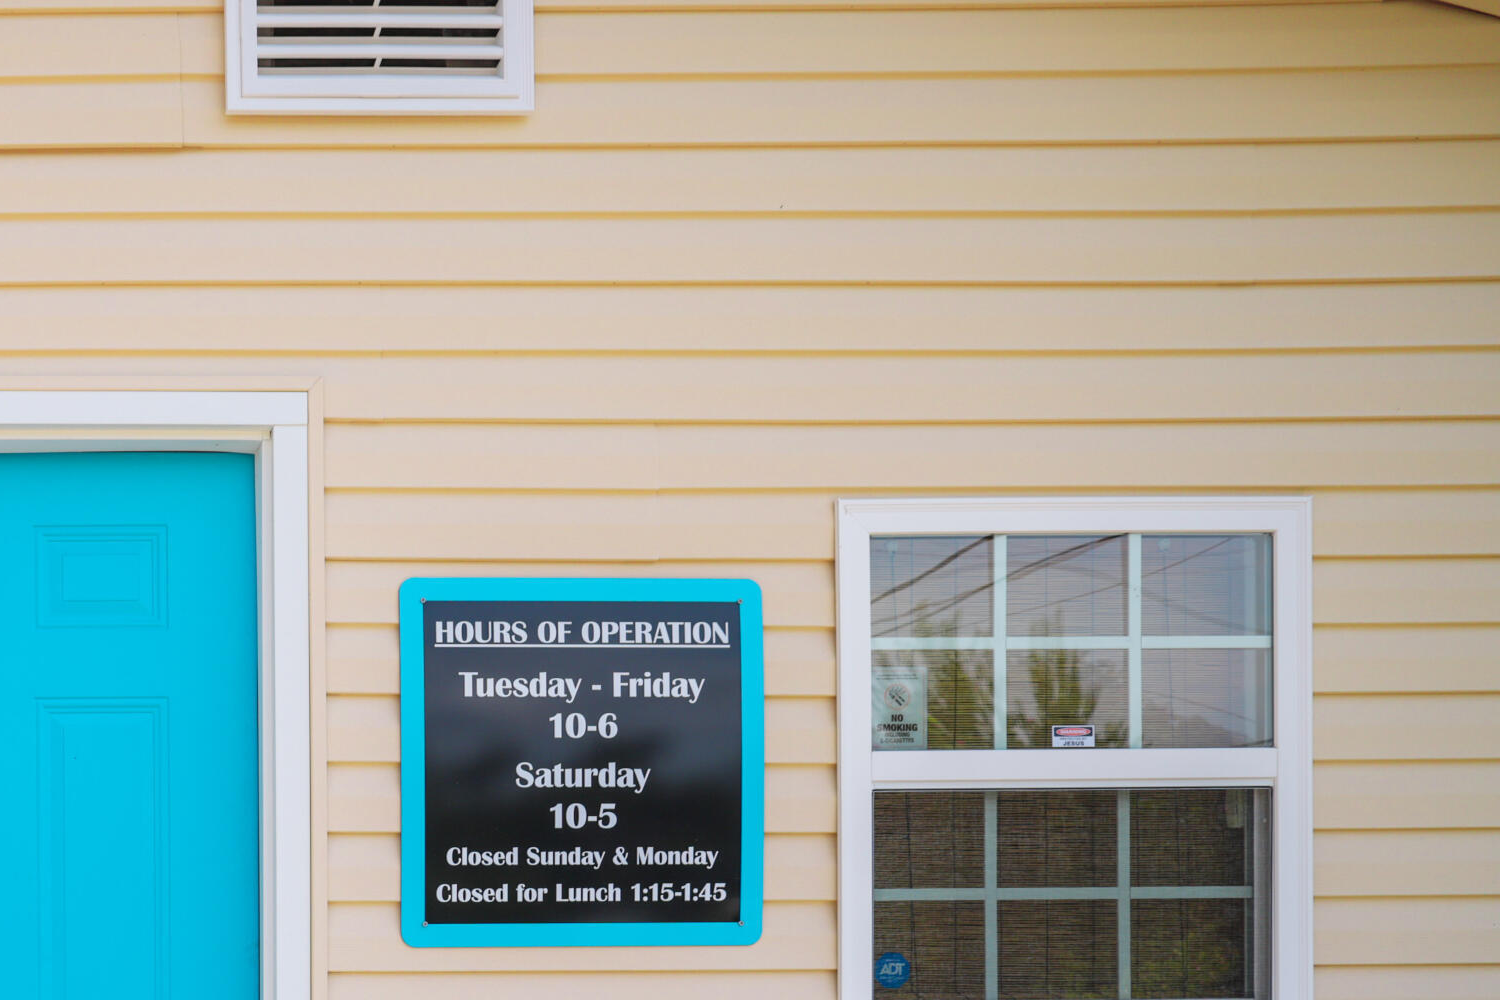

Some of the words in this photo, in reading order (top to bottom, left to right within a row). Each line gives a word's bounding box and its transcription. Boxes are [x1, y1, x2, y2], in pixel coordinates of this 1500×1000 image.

[435, 621, 528, 644] HOURS
[537, 621, 572, 643] OF
[581, 621, 730, 644] OPERATION
[458, 671, 582, 703] Tuesday
[612, 671, 705, 703] Friday
[549, 712, 618, 739] 10-6
[876, 723, 918, 732] SMOKING
[891, 714, 904, 722] NO
[515, 761, 651, 794] Saturday
[549, 802, 618, 829] 10-5
[446, 846, 519, 866] Closed
[526, 846, 606, 869] Sunday
[612, 847, 629, 866] &
[636, 846, 719, 869] Monday
[435, 883, 509, 903] Closed
[515, 883, 549, 903] for
[555, 883, 622, 903] Lunch
[630, 882, 727, 902] 1:15-1:45
[880, 962, 906, 976] ADT
